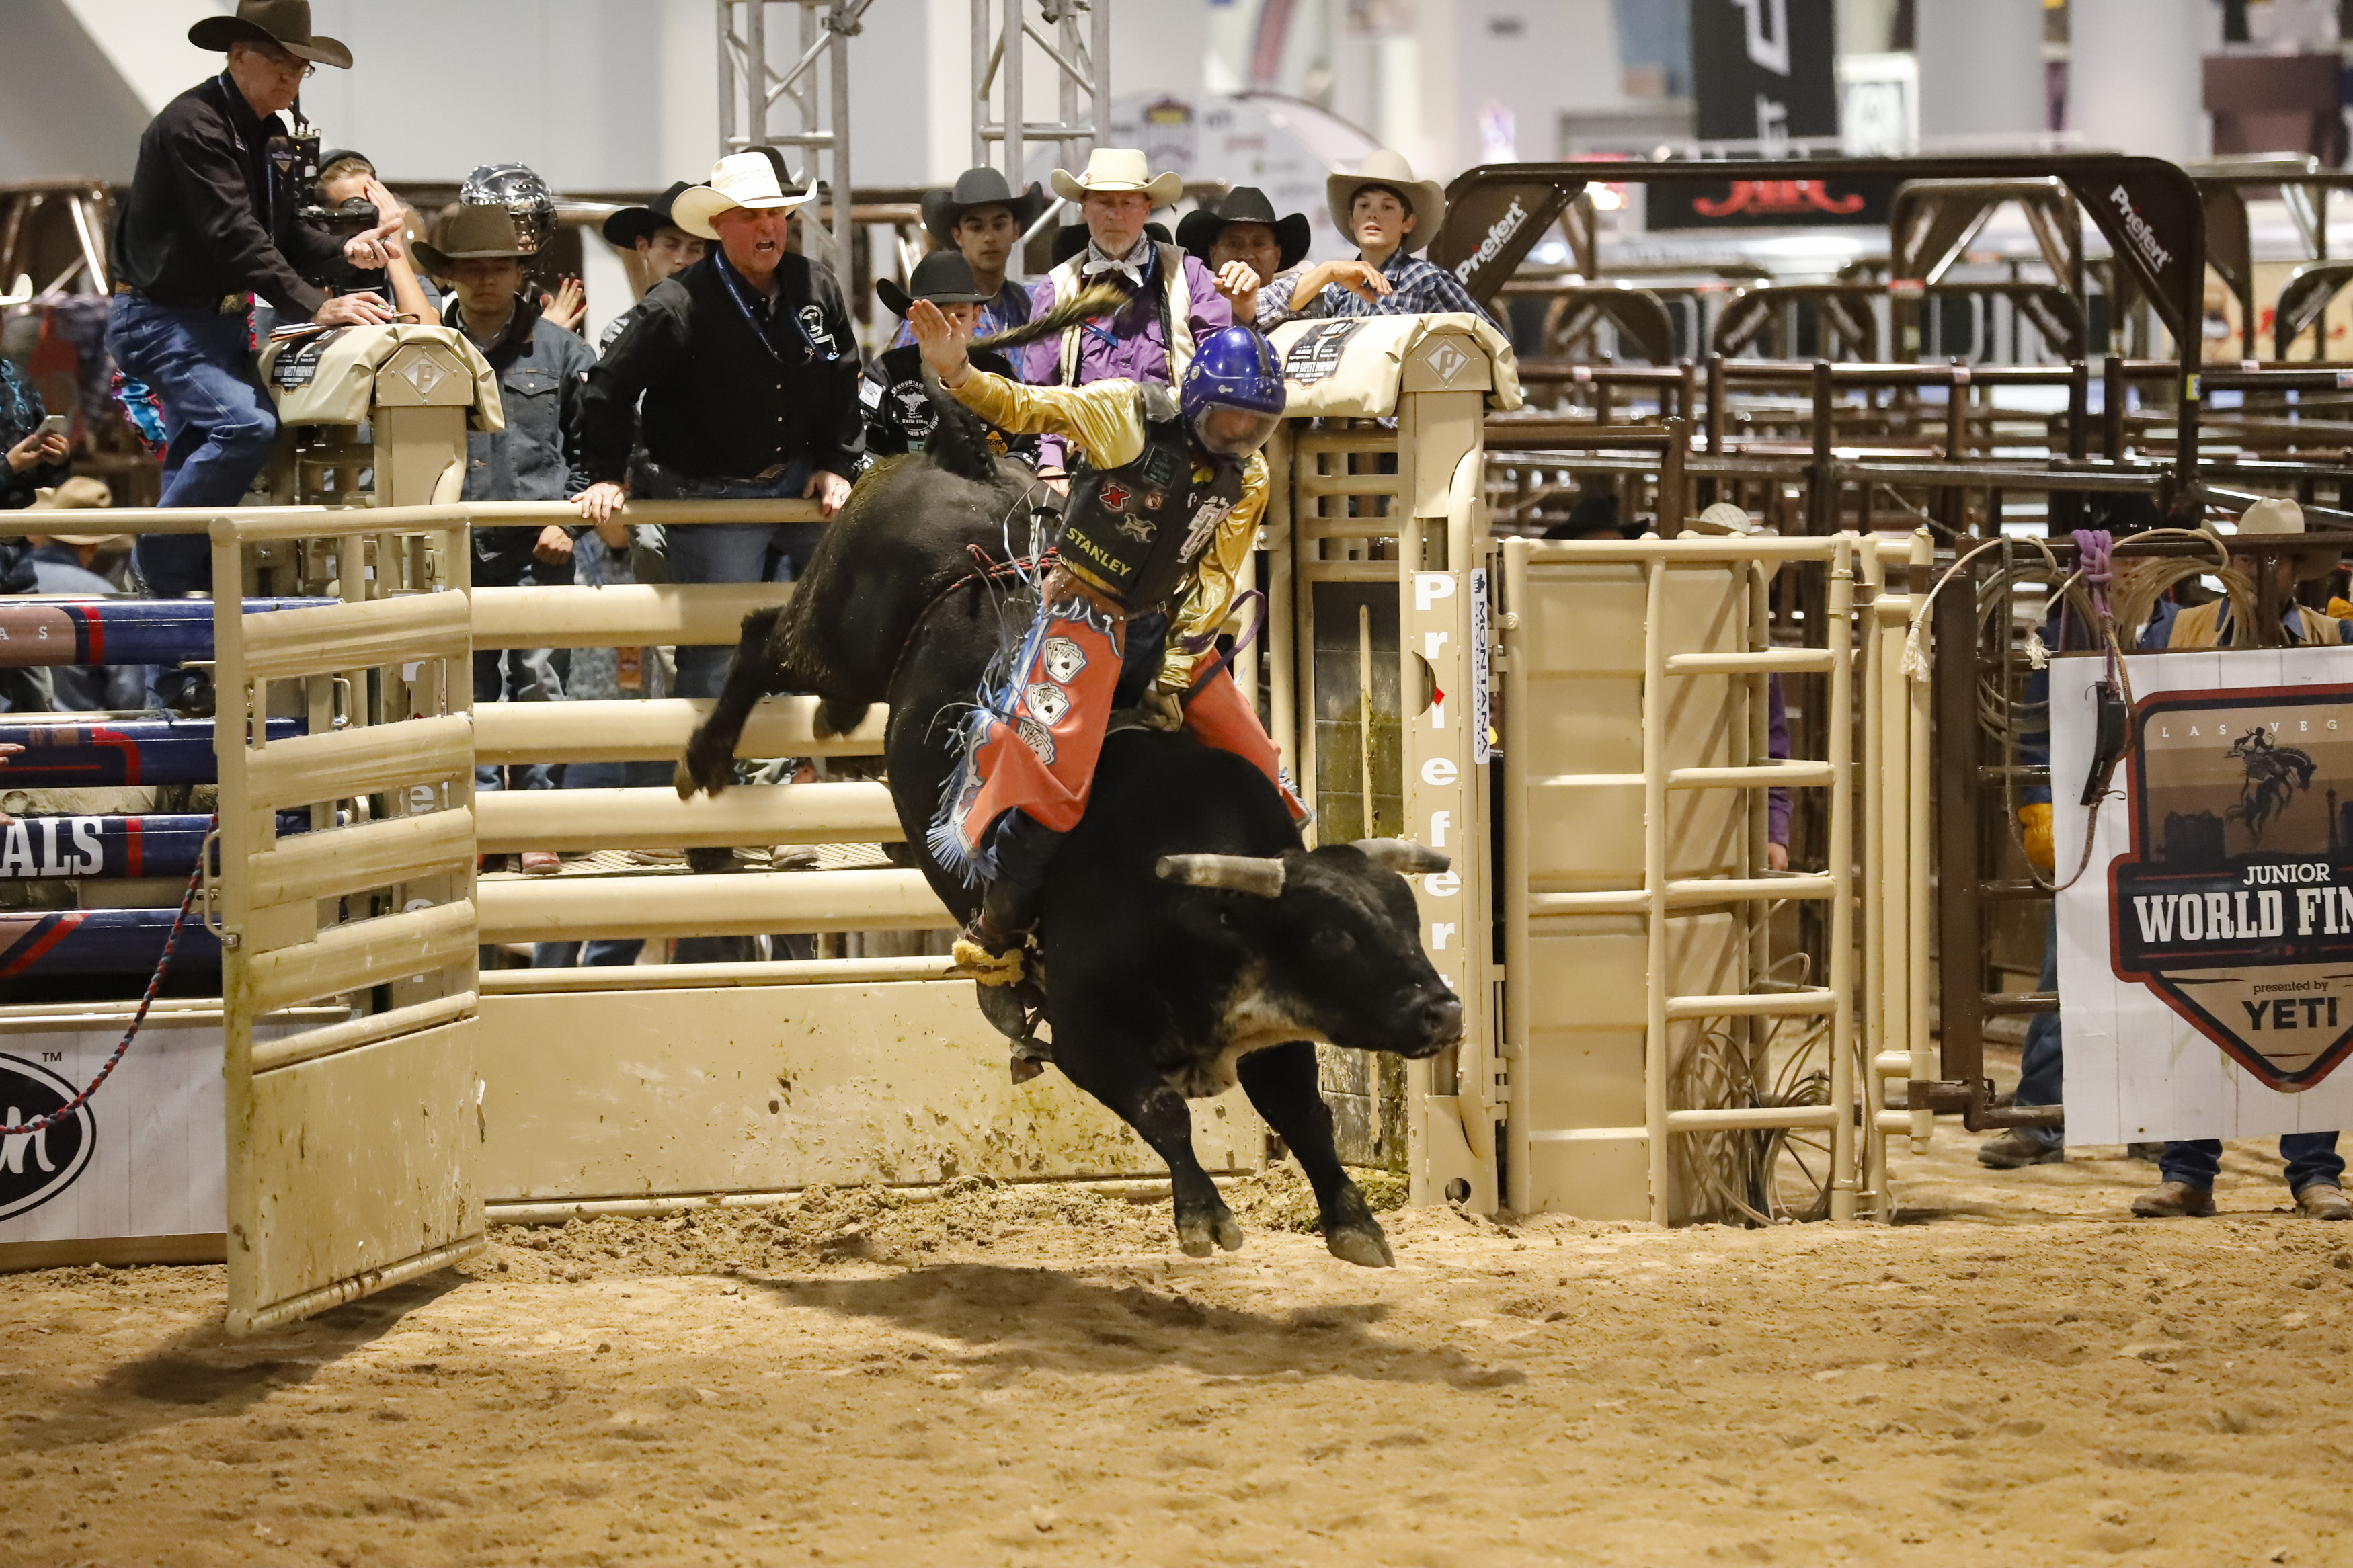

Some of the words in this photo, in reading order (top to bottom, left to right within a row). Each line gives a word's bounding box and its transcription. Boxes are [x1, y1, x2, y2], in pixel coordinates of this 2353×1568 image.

[1454, 202, 1524, 285] Priefert
[2110, 184, 2168, 267] Priefert
[1066, 527, 1131, 577] STANLEY
[1478, 601, 1488, 755] MONTANA
[2161, 724, 2227, 737] LAS
[1415, 574, 1463, 987] Priefer
[2243, 863, 2331, 886] JUNIOR
[2133, 889, 2284, 943] WORLD
[2253, 981, 2311, 995] presented
[2313, 981, 2329, 992] by
[2242, 997, 2338, 1031] YETI
[42, 1052, 62, 1062] TM
